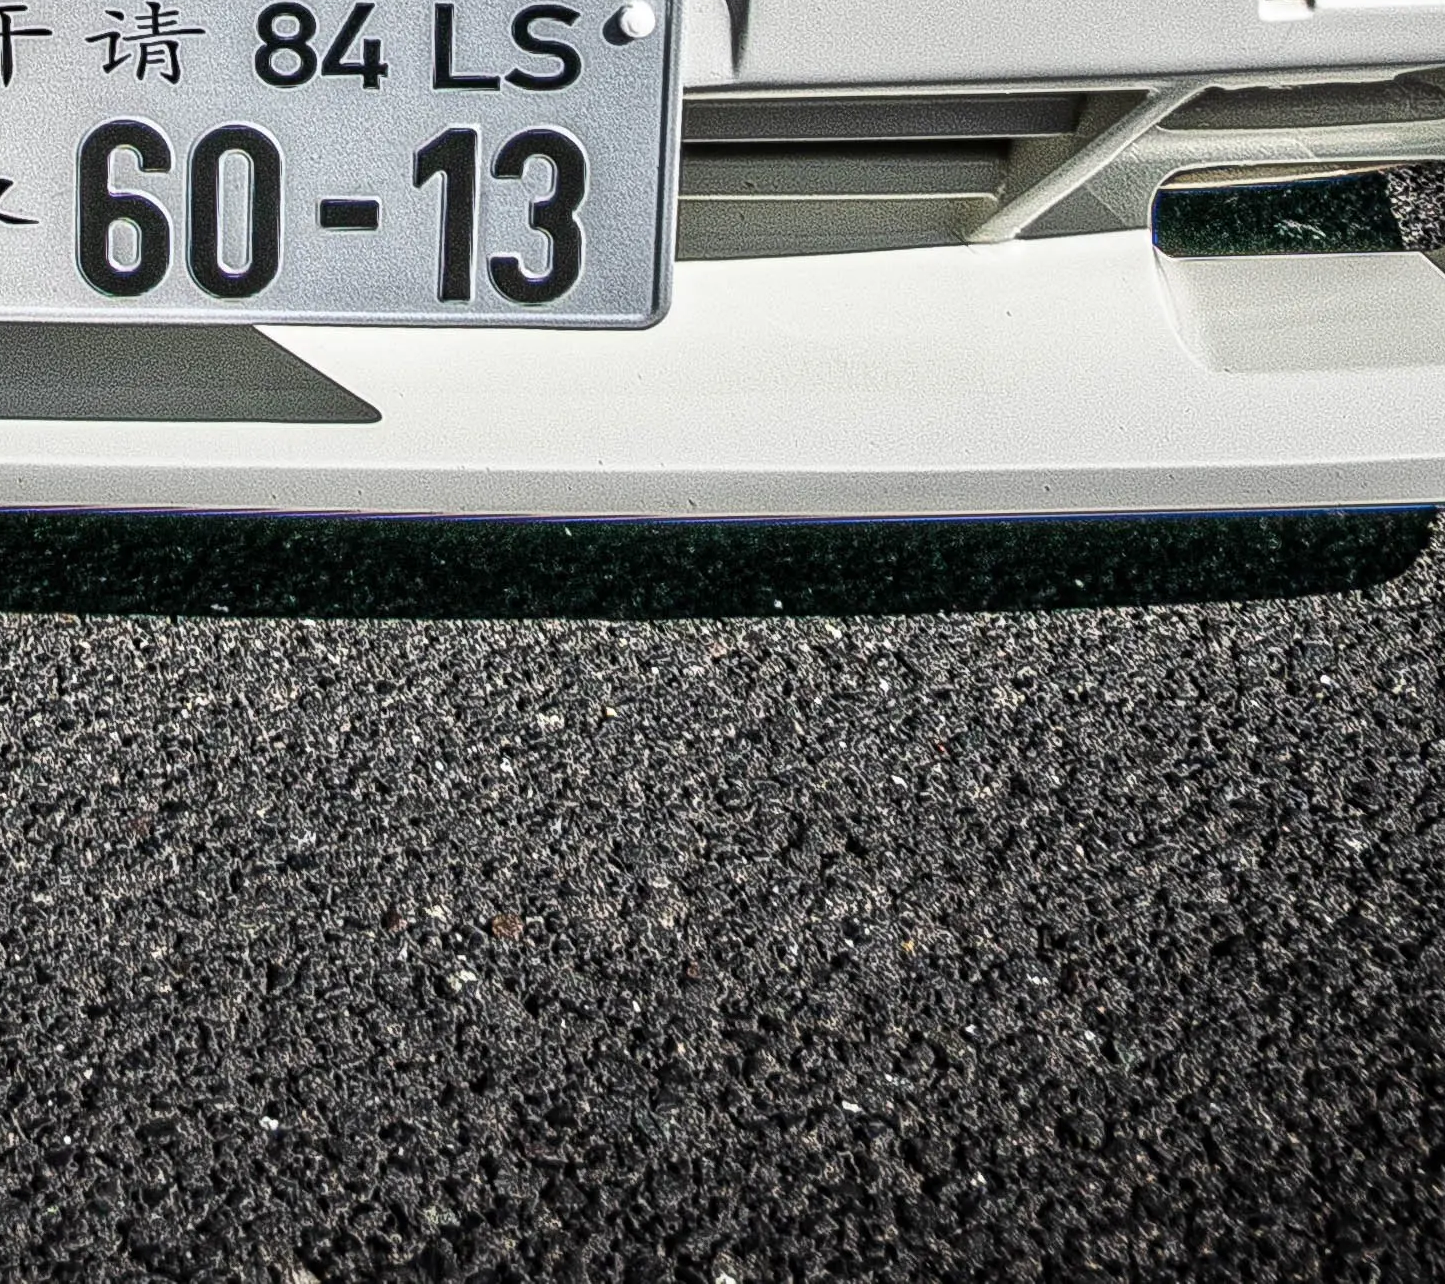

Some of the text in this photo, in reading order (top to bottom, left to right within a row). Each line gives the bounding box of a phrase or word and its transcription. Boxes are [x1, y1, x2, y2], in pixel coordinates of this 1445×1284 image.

[253, 1, 584, 92] 84 LS
[76, 117, 592, 308] 60-13
